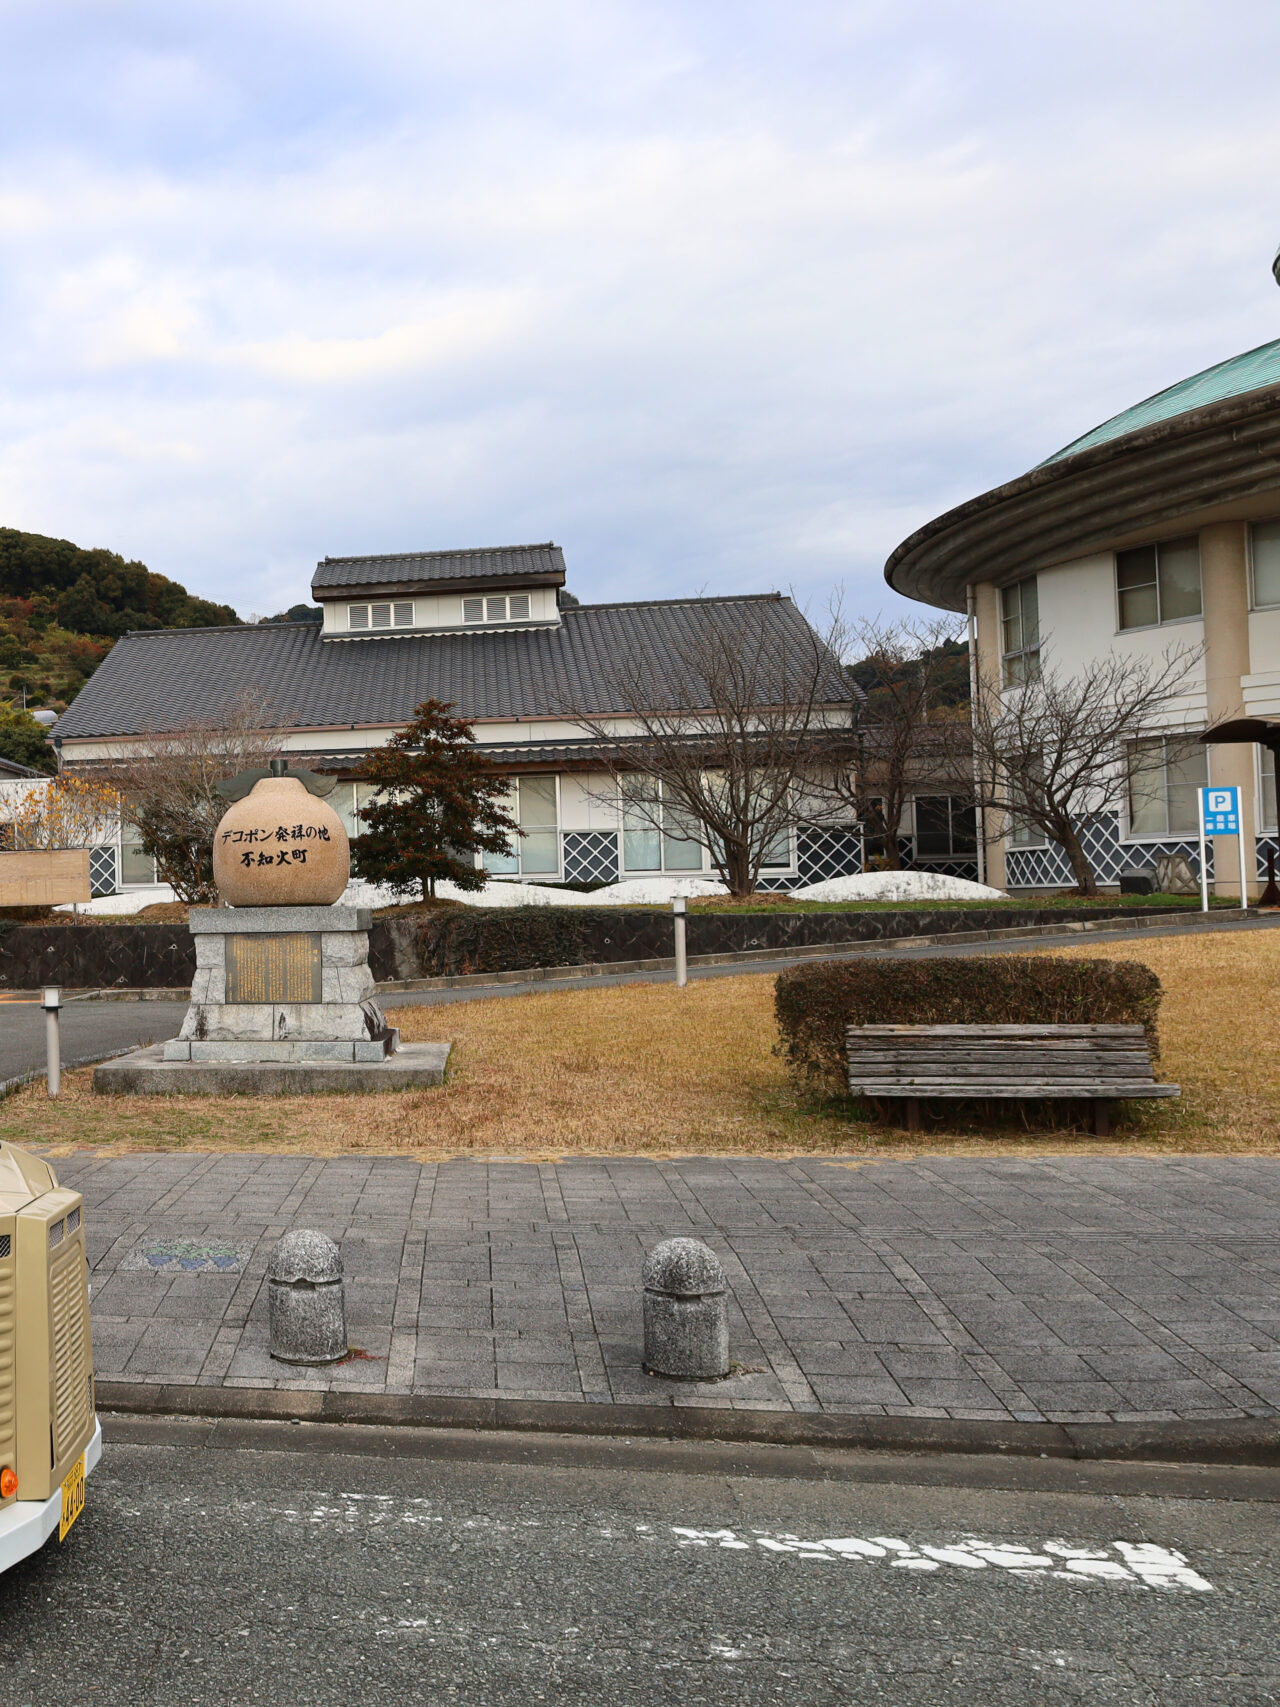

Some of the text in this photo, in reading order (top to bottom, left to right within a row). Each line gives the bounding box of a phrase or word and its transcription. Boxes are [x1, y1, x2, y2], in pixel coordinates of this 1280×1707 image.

[1215, 795, 1226, 808] P
[222, 824, 331, 845] デコポン発祥の地
[240, 848, 308, 868] 不知火町
